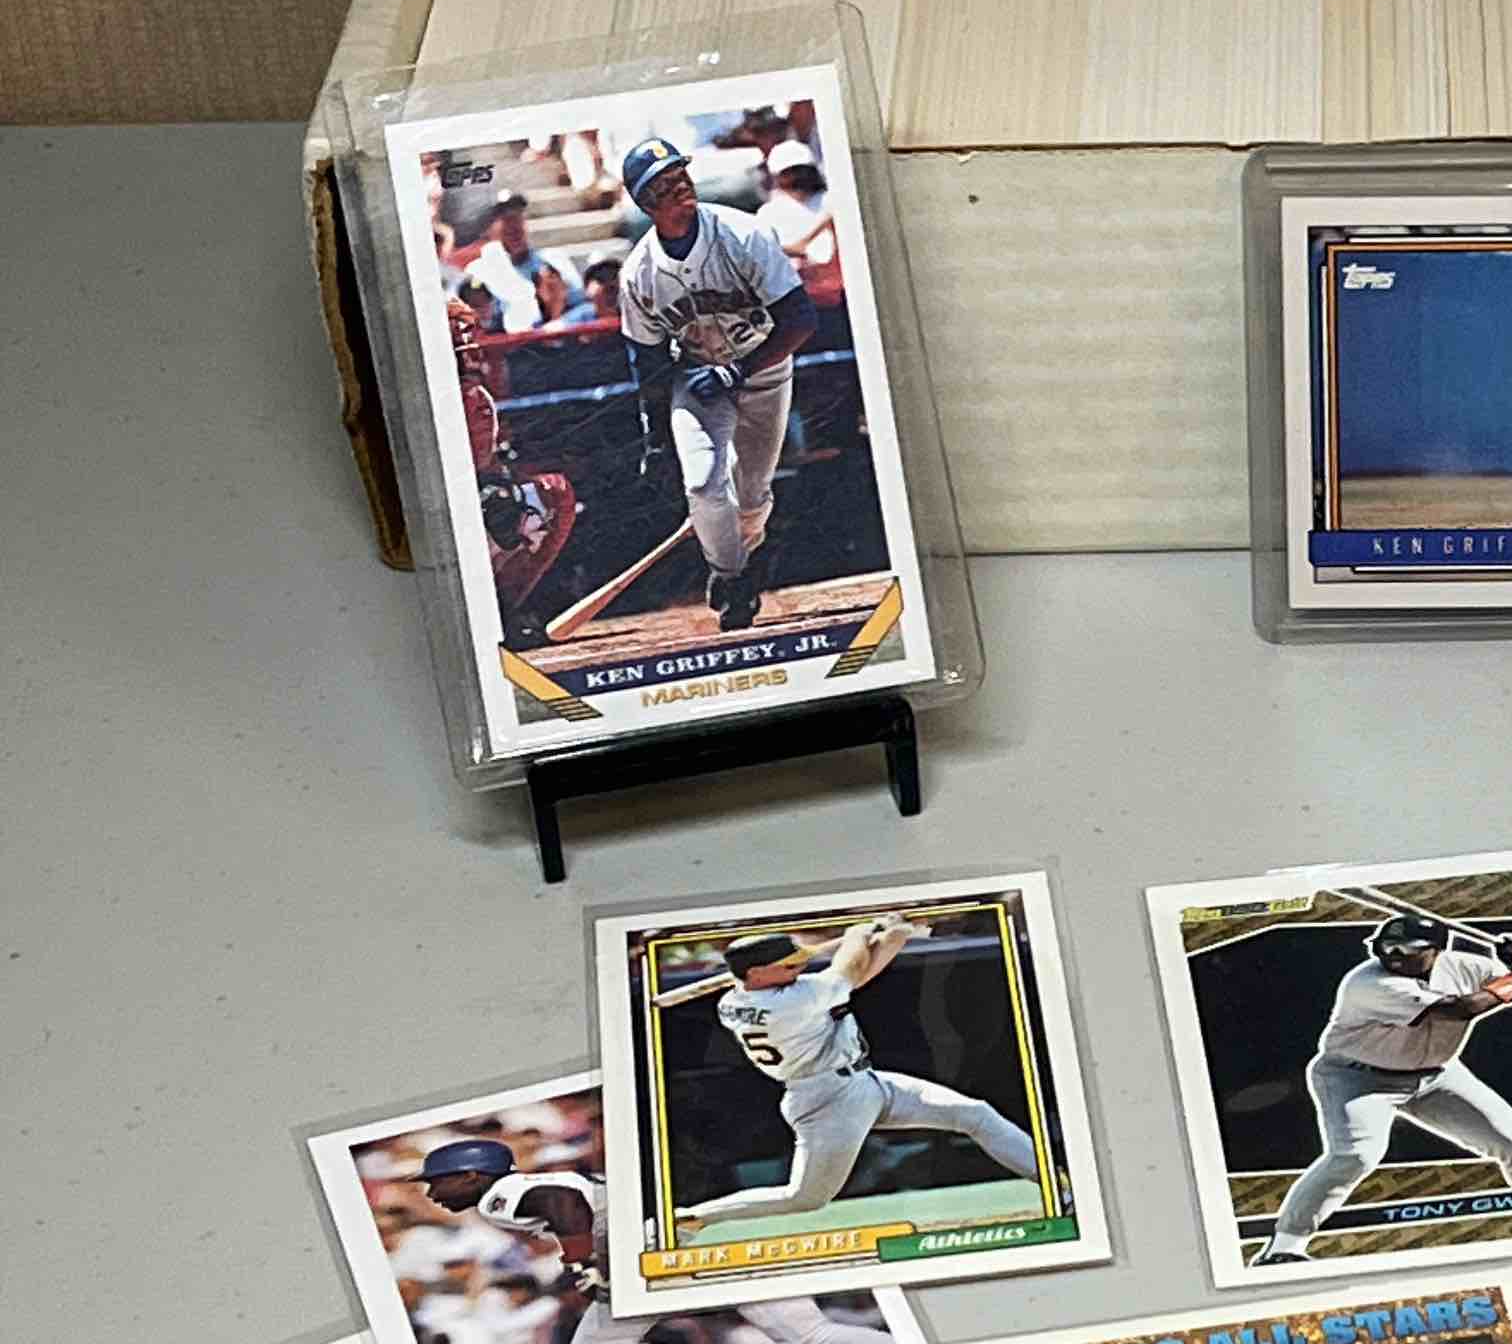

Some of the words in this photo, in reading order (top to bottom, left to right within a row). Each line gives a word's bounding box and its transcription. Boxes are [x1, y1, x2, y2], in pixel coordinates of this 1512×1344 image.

[1373, 535, 1424, 555] KEN
[586, 663, 645, 689] KEN
[640, 667, 789, 708] MARINERS
[1384, 1201, 1465, 1221] TONY
[918, 1225, 1027, 1252] Athletics
[662, 1249, 730, 1269] MARK
